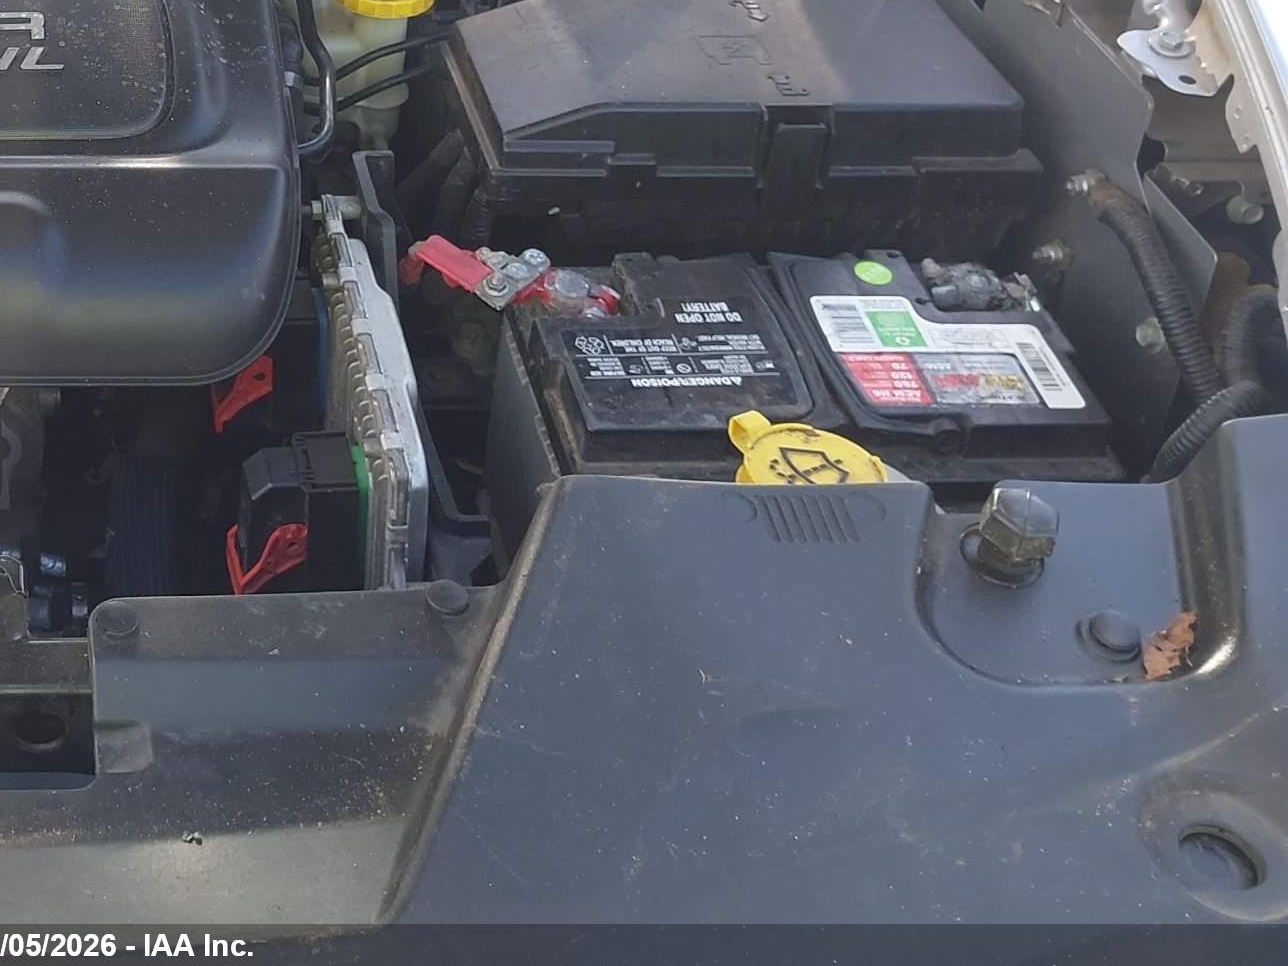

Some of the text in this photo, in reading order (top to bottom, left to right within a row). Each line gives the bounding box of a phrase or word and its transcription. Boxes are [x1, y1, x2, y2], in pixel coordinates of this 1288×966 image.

[681, 302, 729, 312] BATTERY!
[675, 312, 744, 323] DO NOT OPEN
